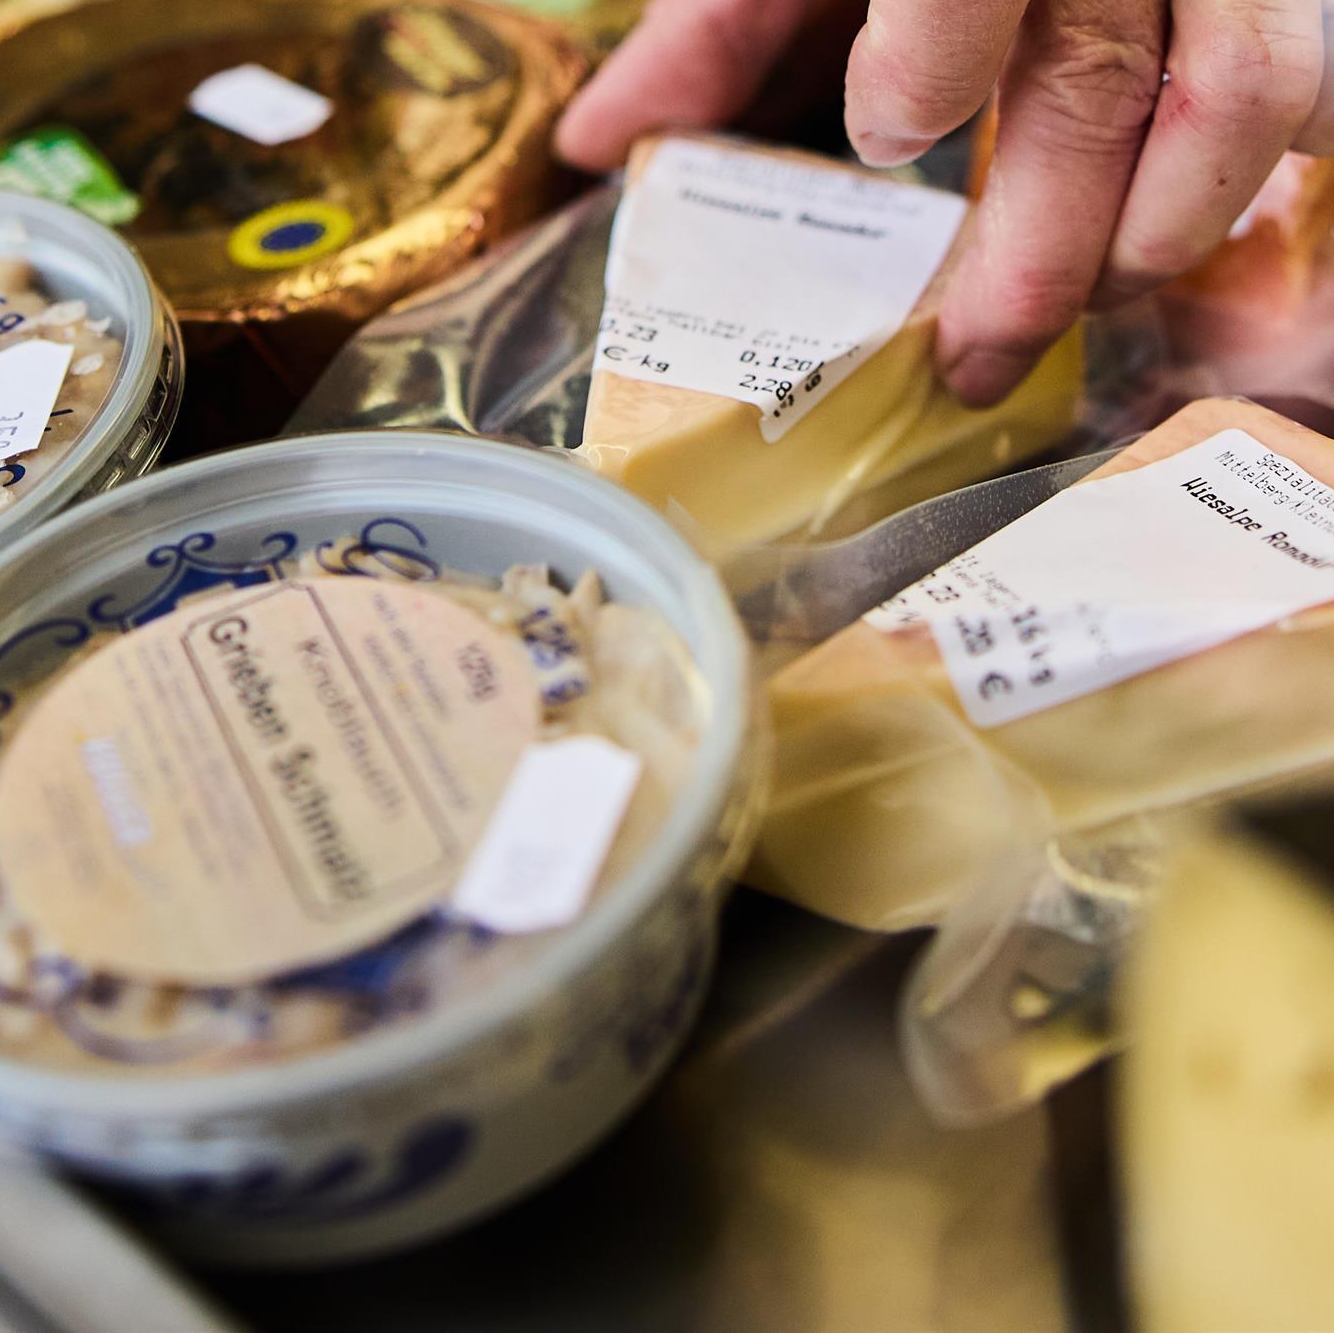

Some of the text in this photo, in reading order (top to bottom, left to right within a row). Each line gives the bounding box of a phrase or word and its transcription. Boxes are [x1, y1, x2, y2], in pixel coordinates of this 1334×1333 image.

[1180, 476, 1264, 533] Wiesalpe
[208, 614, 371, 906] Grieben Schmalz
[296, 636, 407, 826] Knoblauch
